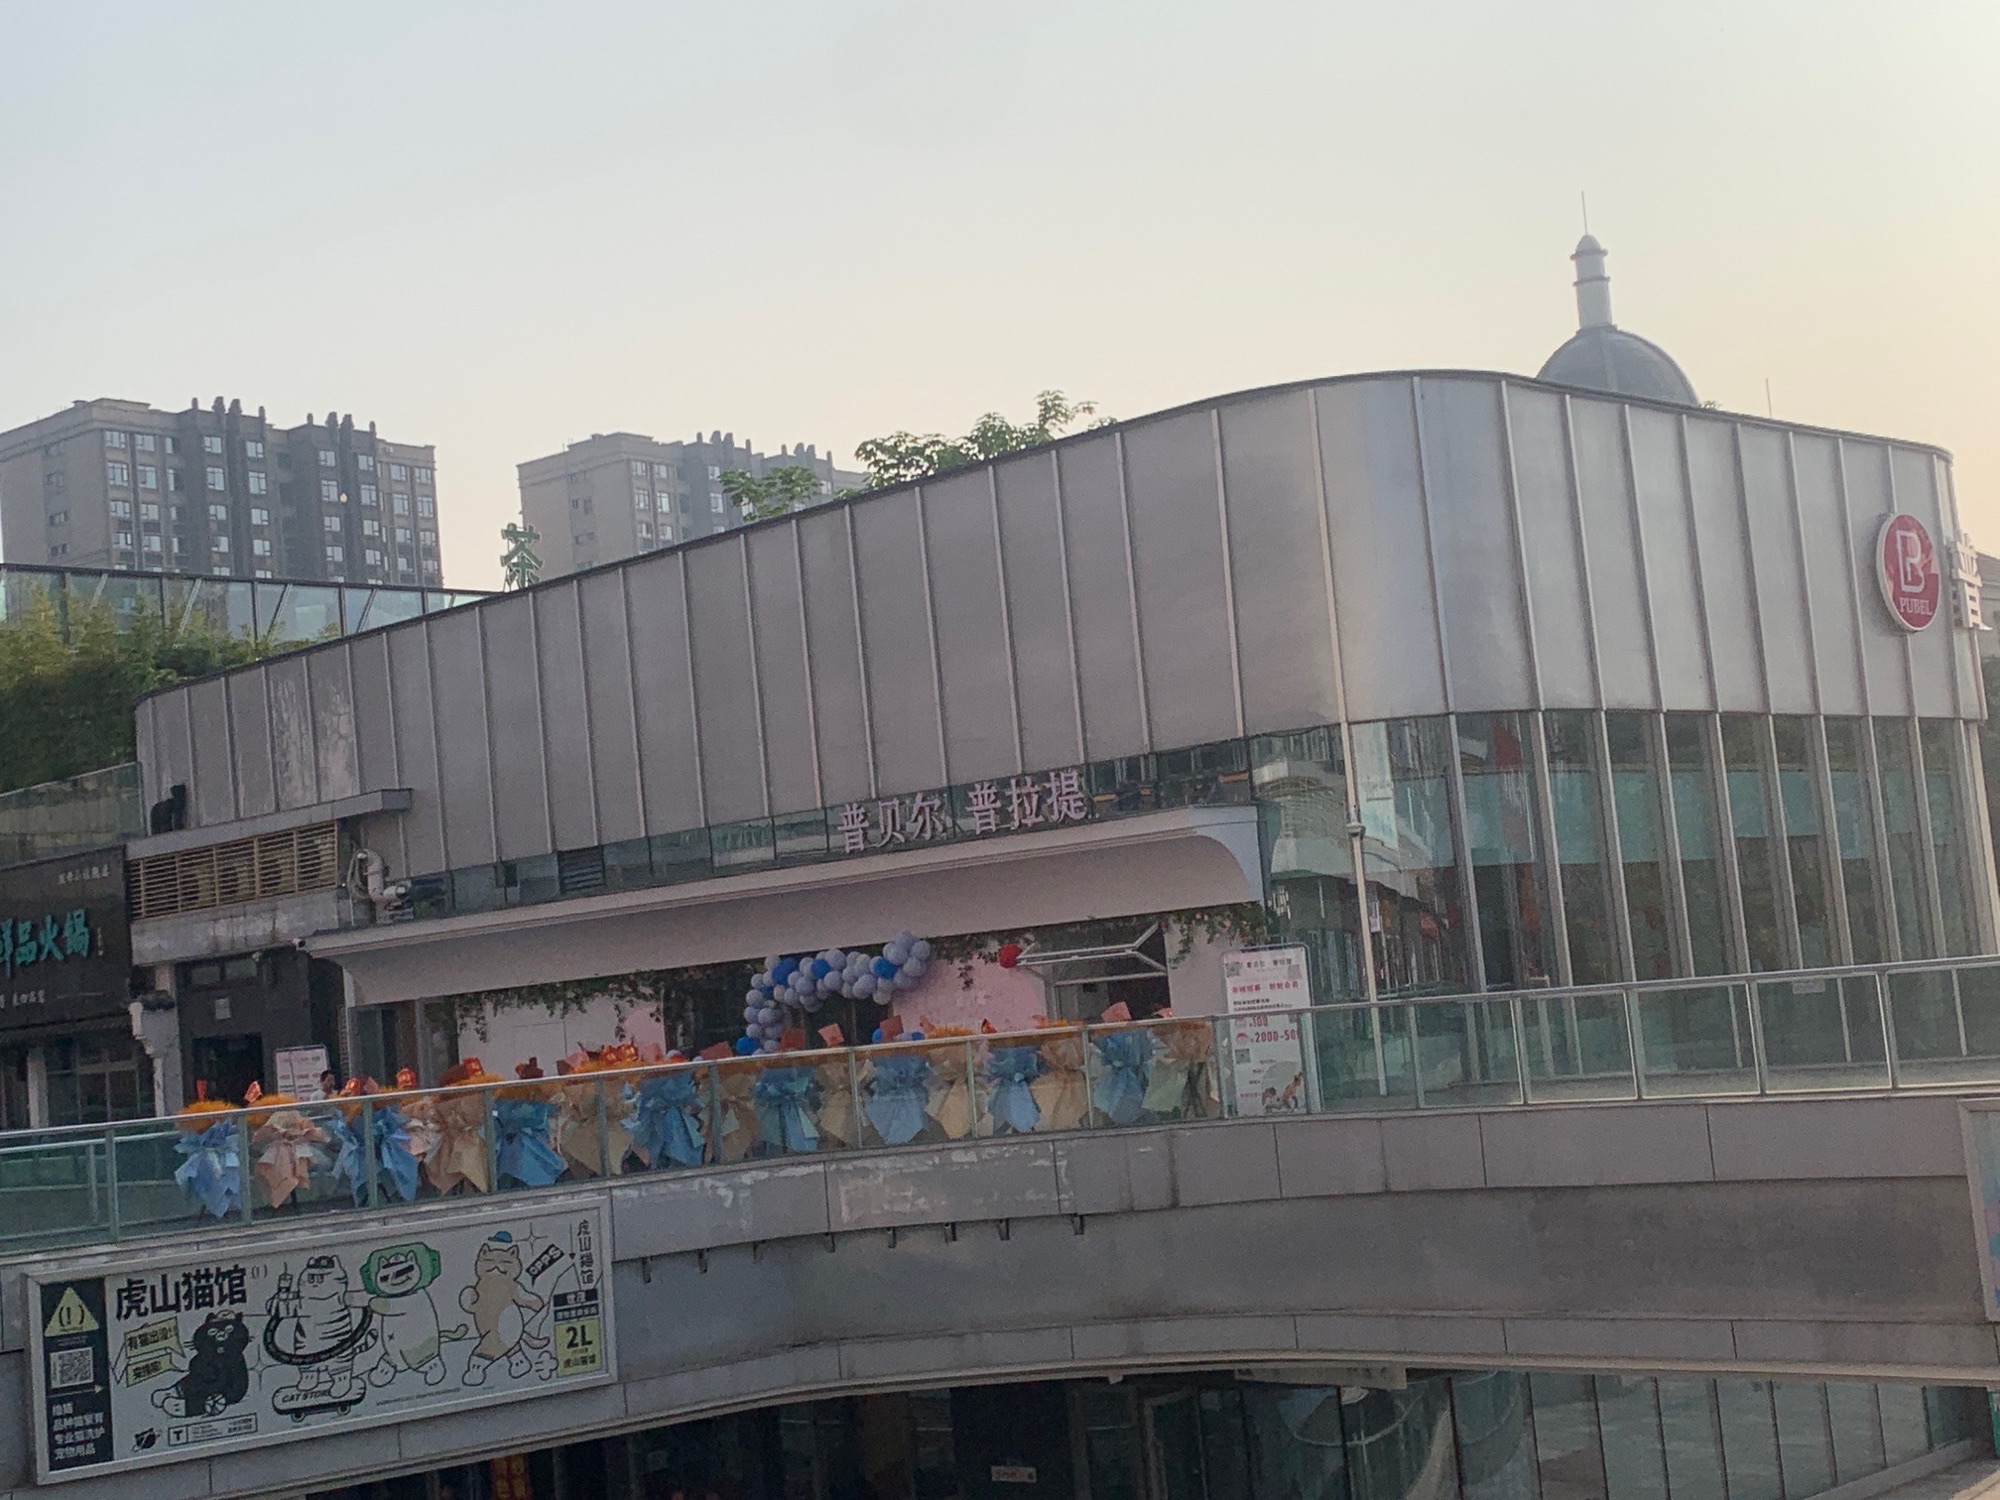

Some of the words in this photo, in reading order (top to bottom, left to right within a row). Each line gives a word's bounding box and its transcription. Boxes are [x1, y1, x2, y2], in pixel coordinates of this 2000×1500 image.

[838, 793, 943, 853] 普贝尔
[966, 768, 1088, 835] 普拉提
[116, 1264, 247, 1321] 虎山猫馆
[565, 1325, 593, 1350] 2L
